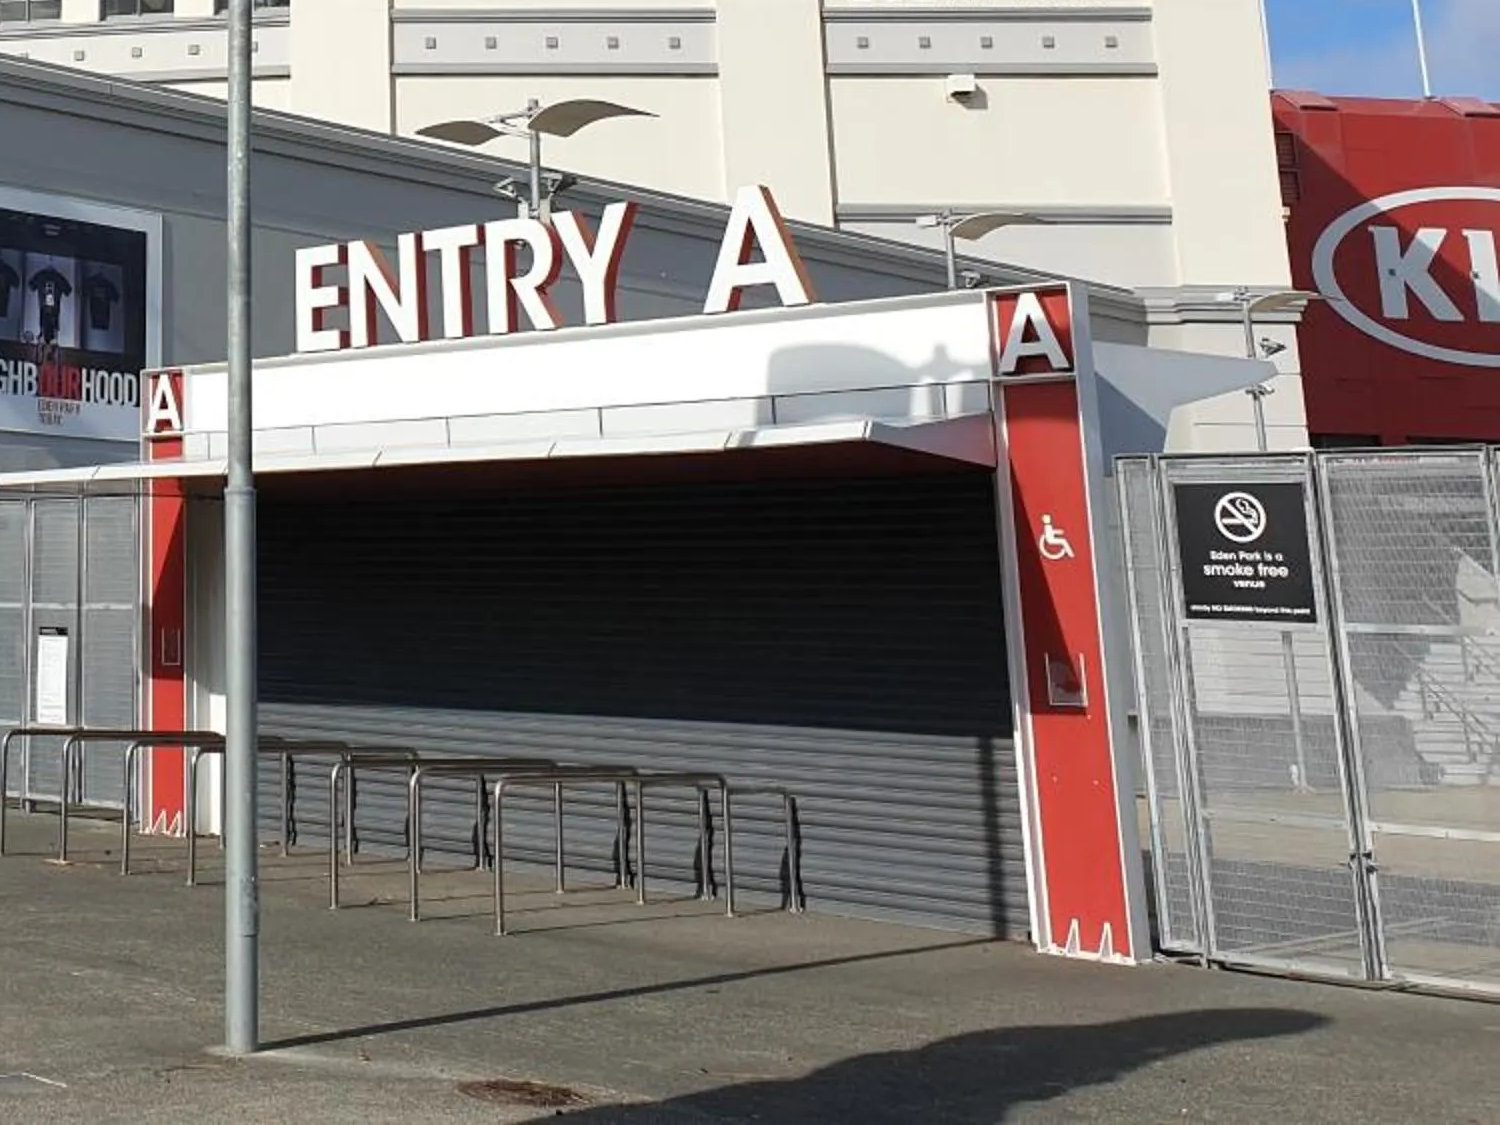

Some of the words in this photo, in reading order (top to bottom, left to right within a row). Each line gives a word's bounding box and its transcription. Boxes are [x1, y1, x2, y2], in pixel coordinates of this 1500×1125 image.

[295, 201, 639, 353] ENTRY
[703, 184, 817, 314] A
[999, 292, 1070, 373] A
[145, 373, 183, 432] A
[1203, 562, 1255, 576] smoke
[1257, 562, 1289, 577] free
[1209, 550, 1237, 561] Eden
[1239, 550, 1262, 561] Park
[1264, 550, 1273, 561] is
[1274, 552, 1284, 562] a
[1233, 579, 1266, 589] venue
